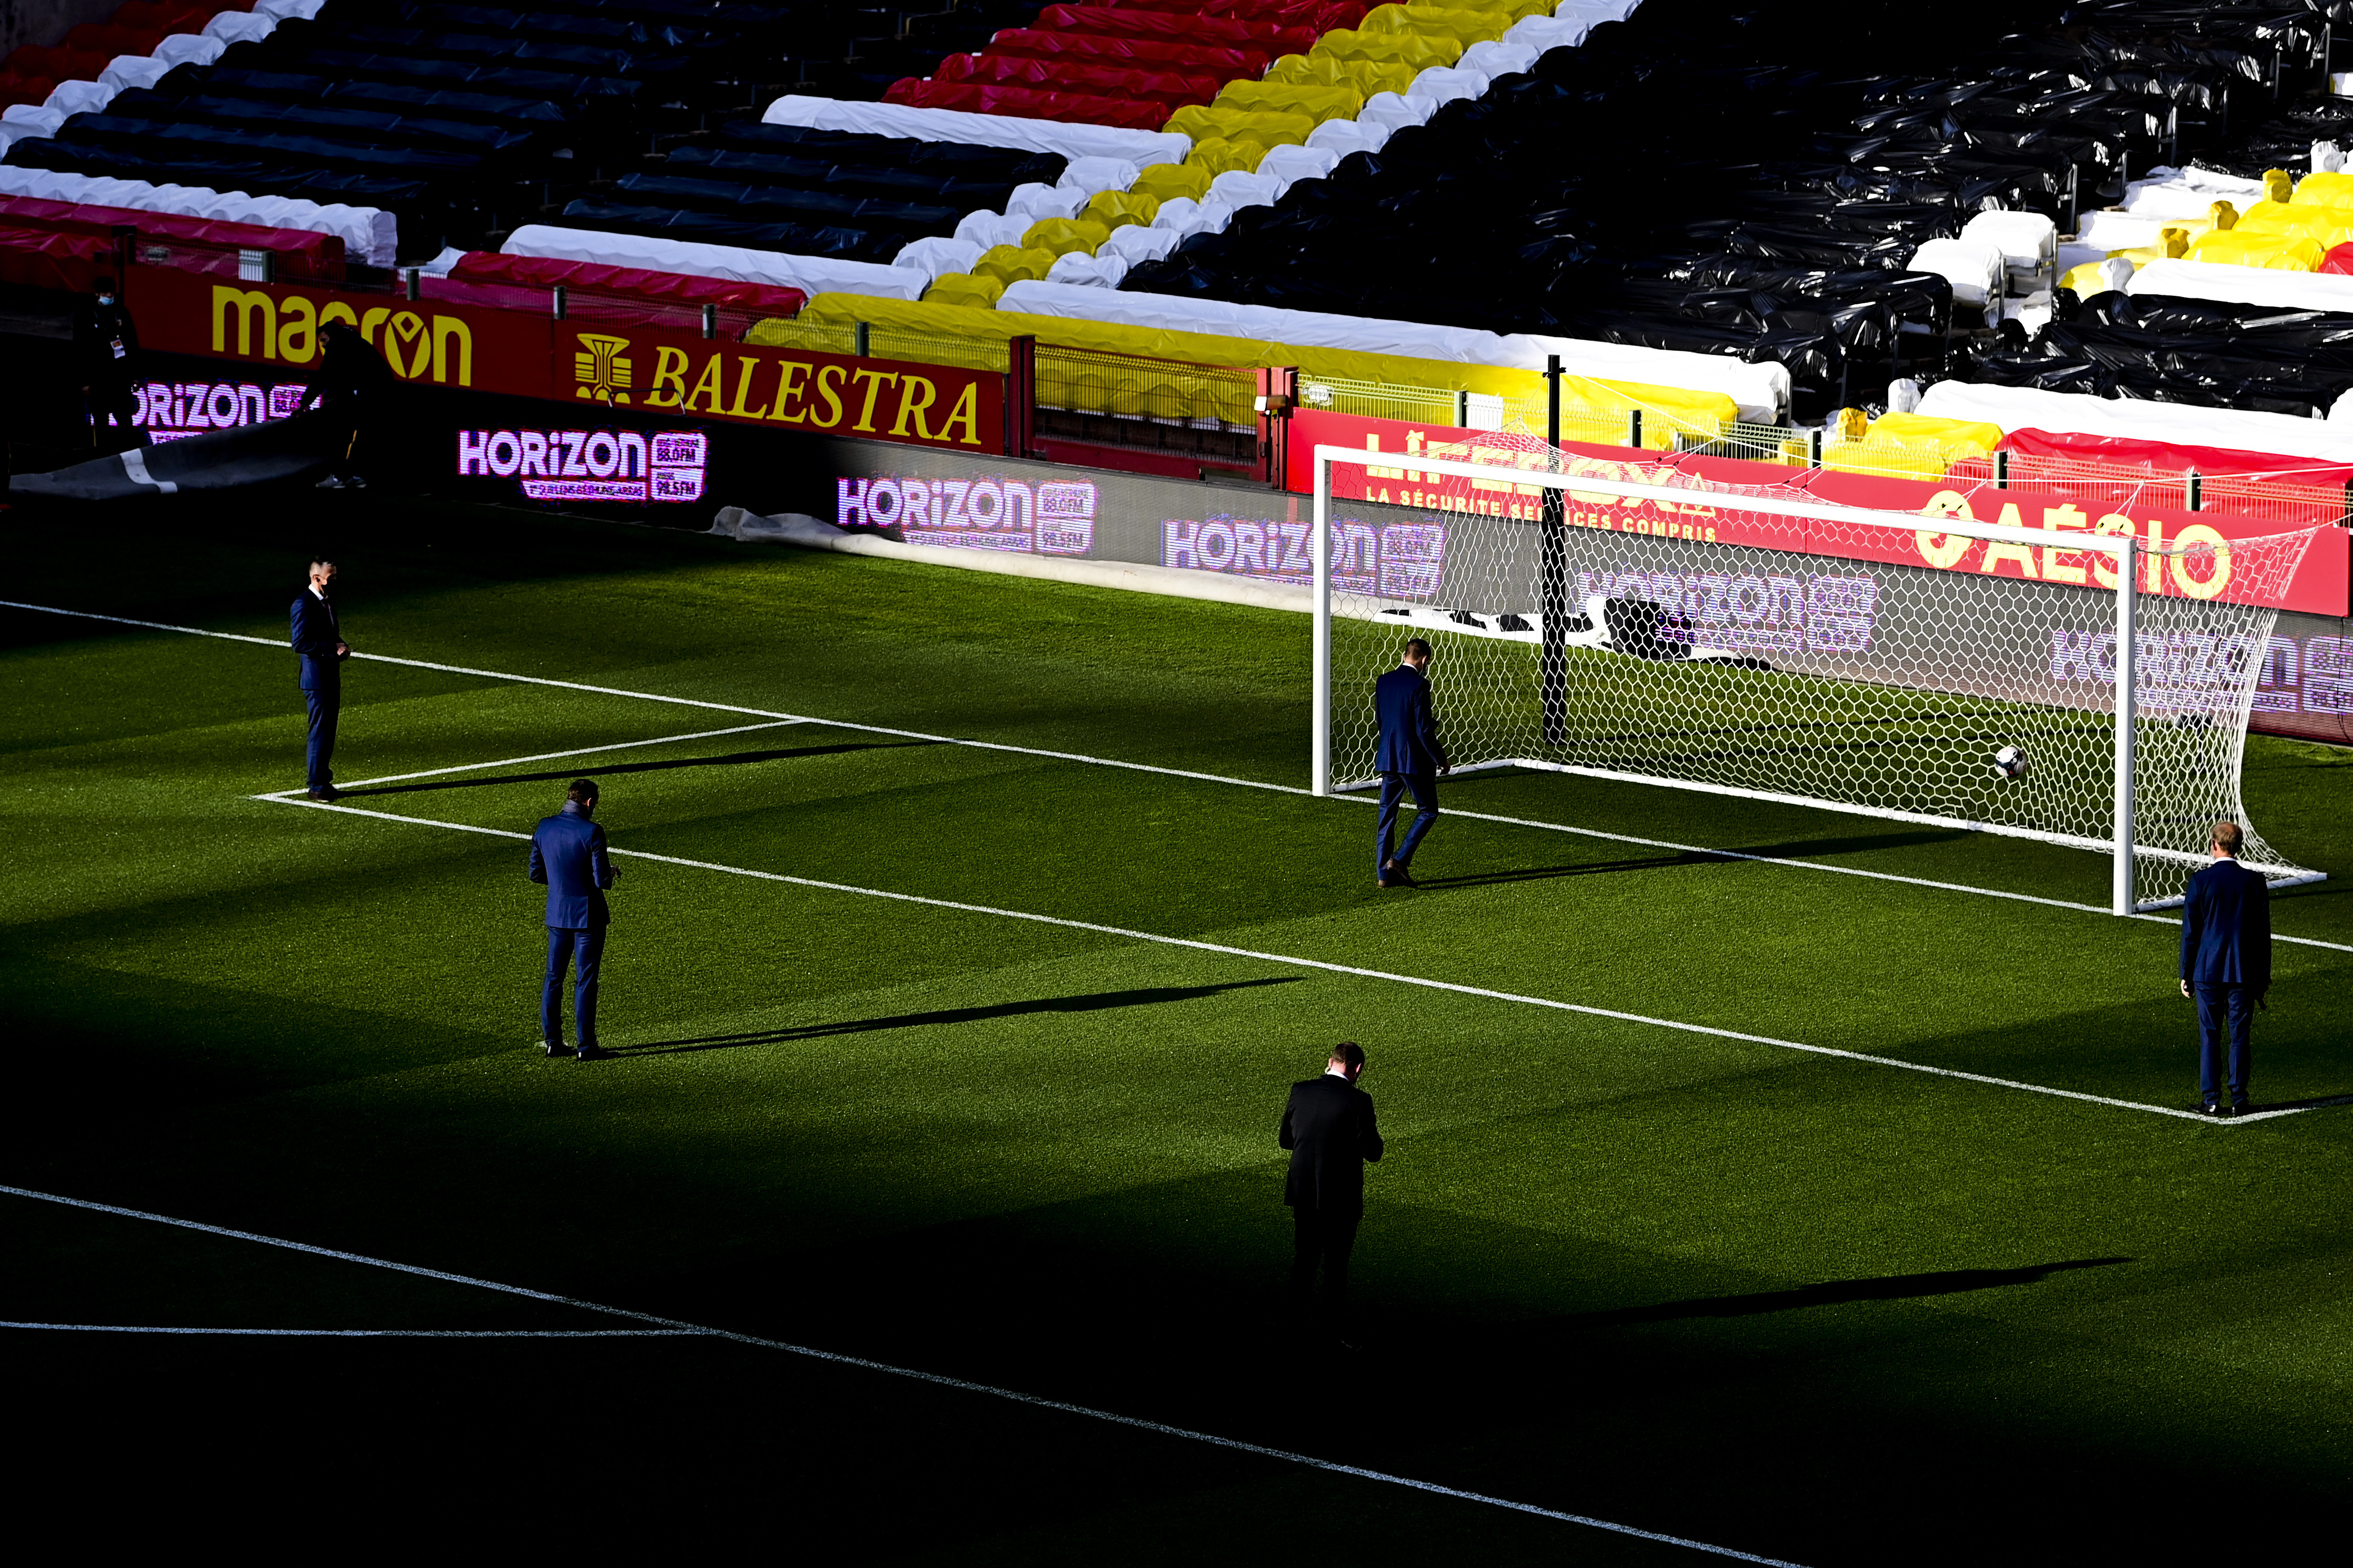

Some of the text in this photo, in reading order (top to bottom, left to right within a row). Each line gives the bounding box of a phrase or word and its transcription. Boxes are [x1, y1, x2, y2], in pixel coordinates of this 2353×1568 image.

[644, 346, 982, 445] BALESTRA
[1366, 486, 1389, 503] LA
[1512, 504, 1611, 530] SEICES
[1622, 517, 1715, 542] COMPRIS
[1980, 503, 2231, 600] AÉSIO
